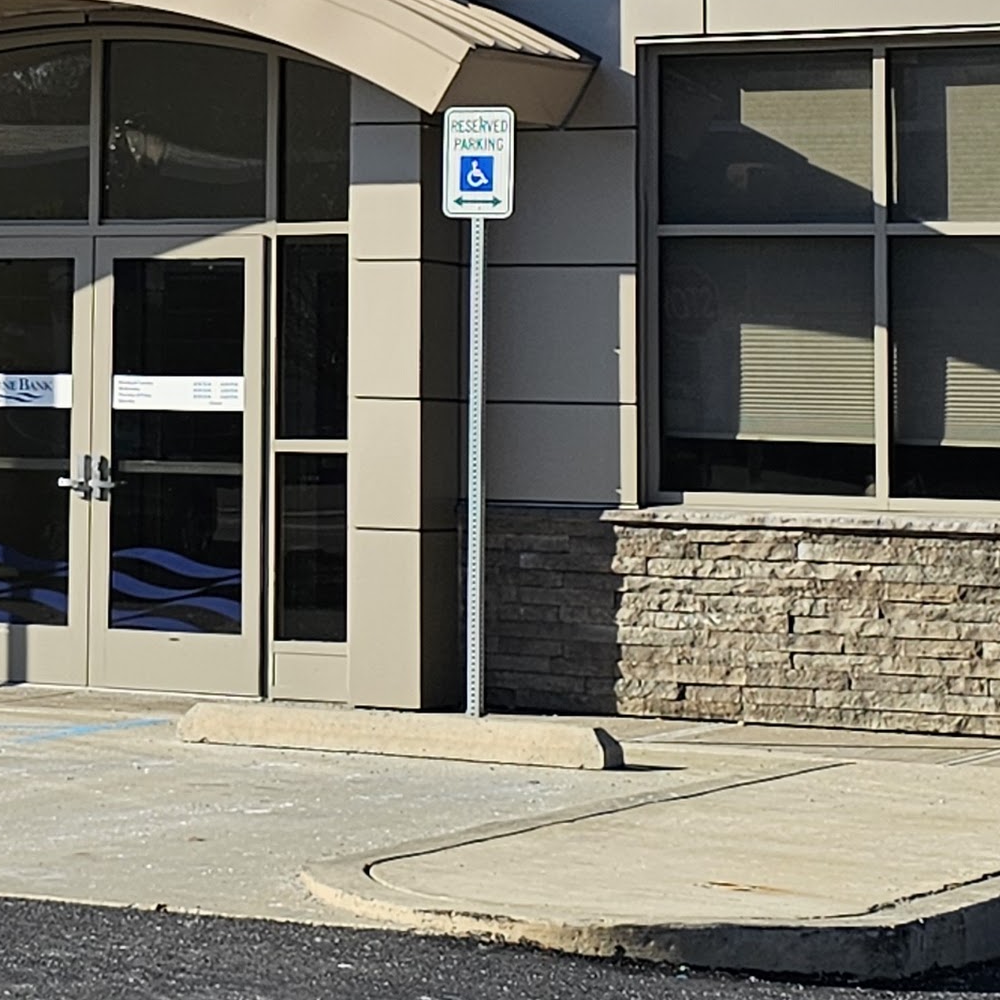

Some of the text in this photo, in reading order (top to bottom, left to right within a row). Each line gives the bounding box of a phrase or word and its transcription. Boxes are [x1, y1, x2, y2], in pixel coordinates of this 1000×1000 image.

[452, 119, 508, 133] RESERVED
[454, 138, 504, 151] PARKING
[19, 378, 52, 391] BANK
